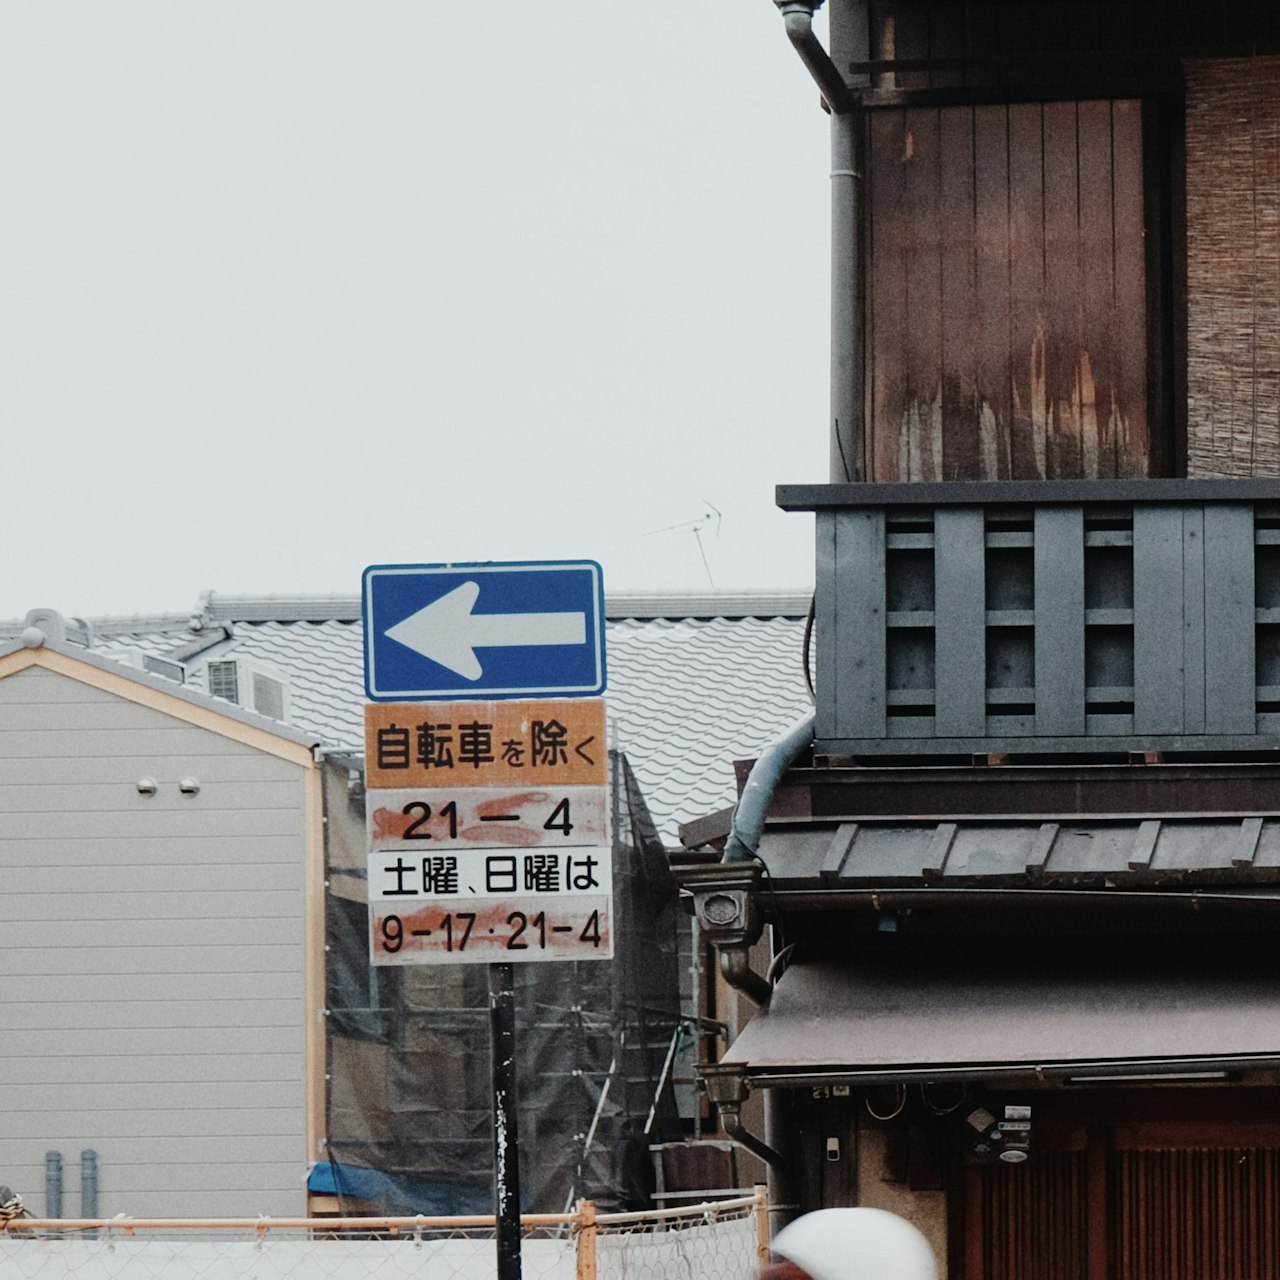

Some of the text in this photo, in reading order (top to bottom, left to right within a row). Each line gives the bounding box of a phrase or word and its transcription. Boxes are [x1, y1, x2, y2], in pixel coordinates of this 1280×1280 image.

[377, 719, 596, 769] 自転車を除く
[382, 855, 600, 895] 土曜、日曜は
